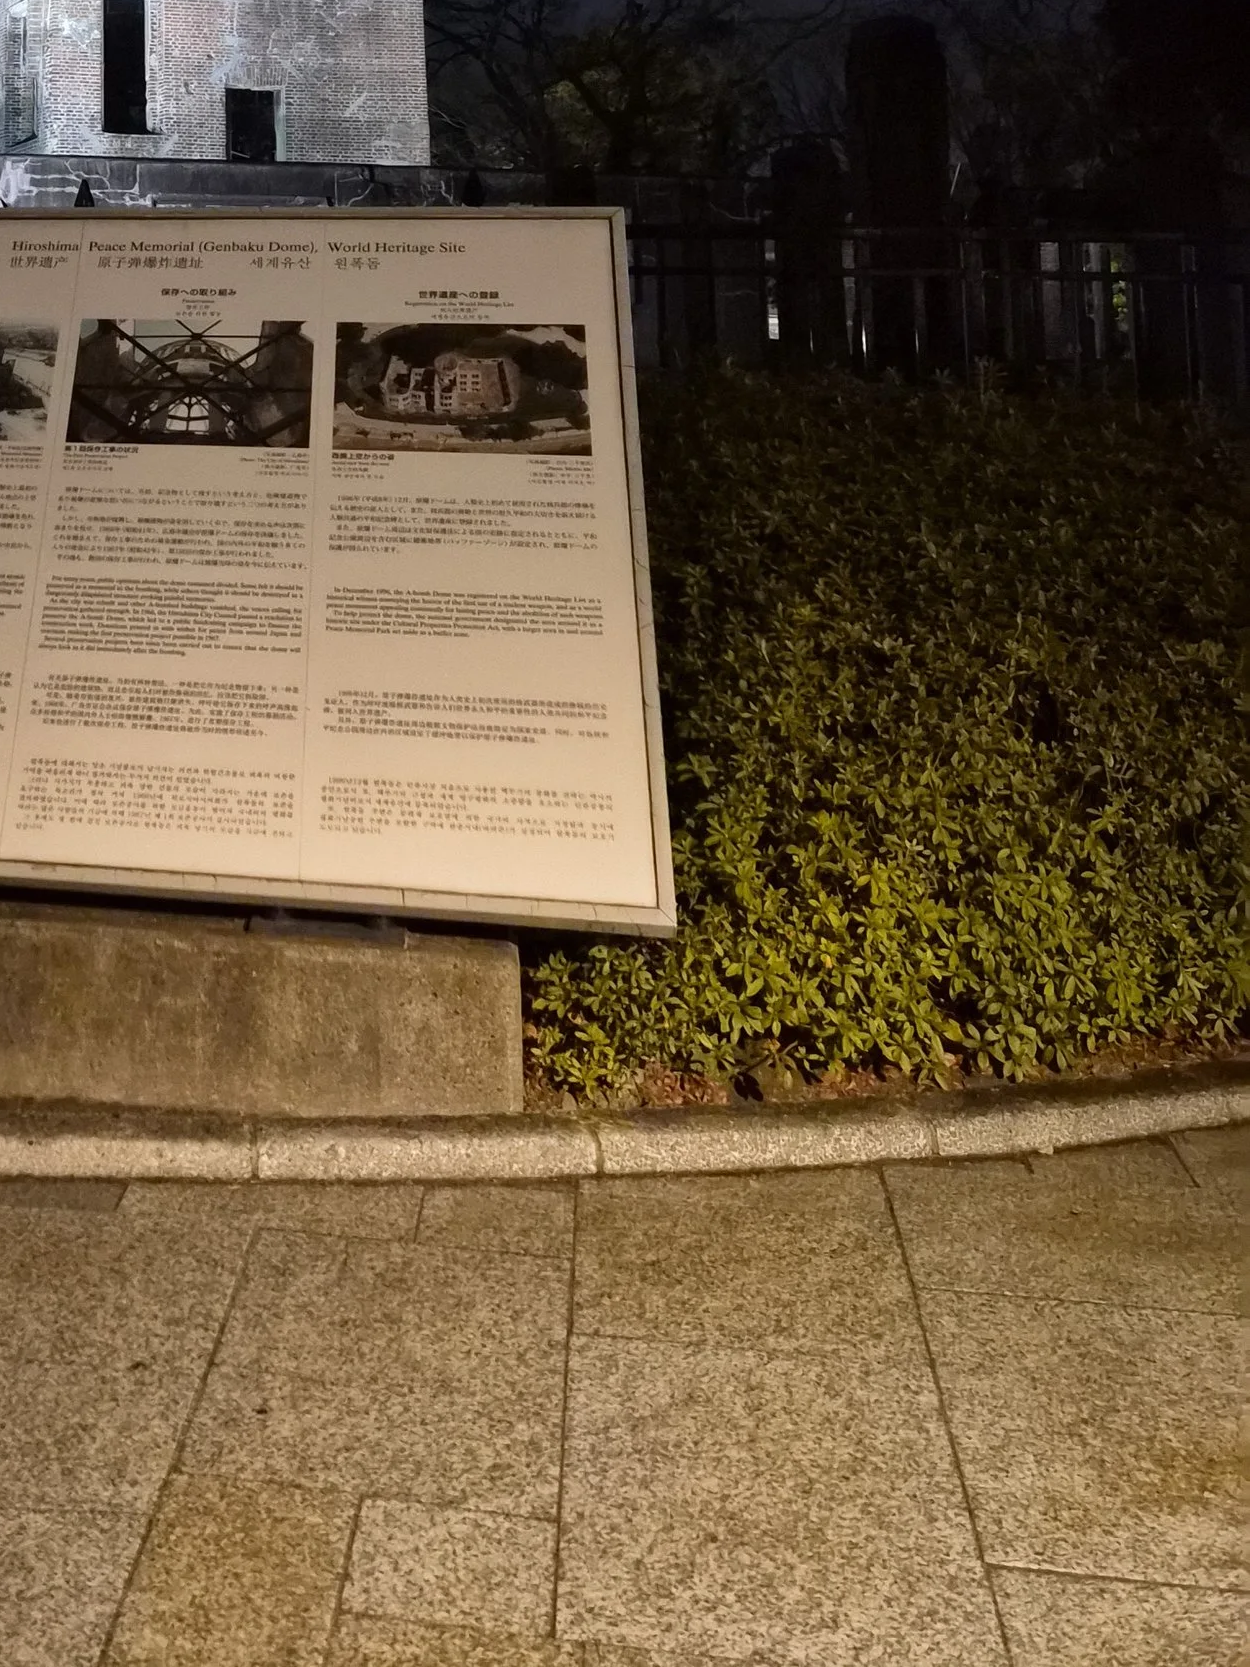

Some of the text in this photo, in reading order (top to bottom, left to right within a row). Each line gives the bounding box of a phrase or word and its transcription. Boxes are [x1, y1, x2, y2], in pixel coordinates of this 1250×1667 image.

[12, 241, 466, 255] Hiroshima Peace Memorial (Genbaku Dome), World Heritage Site
